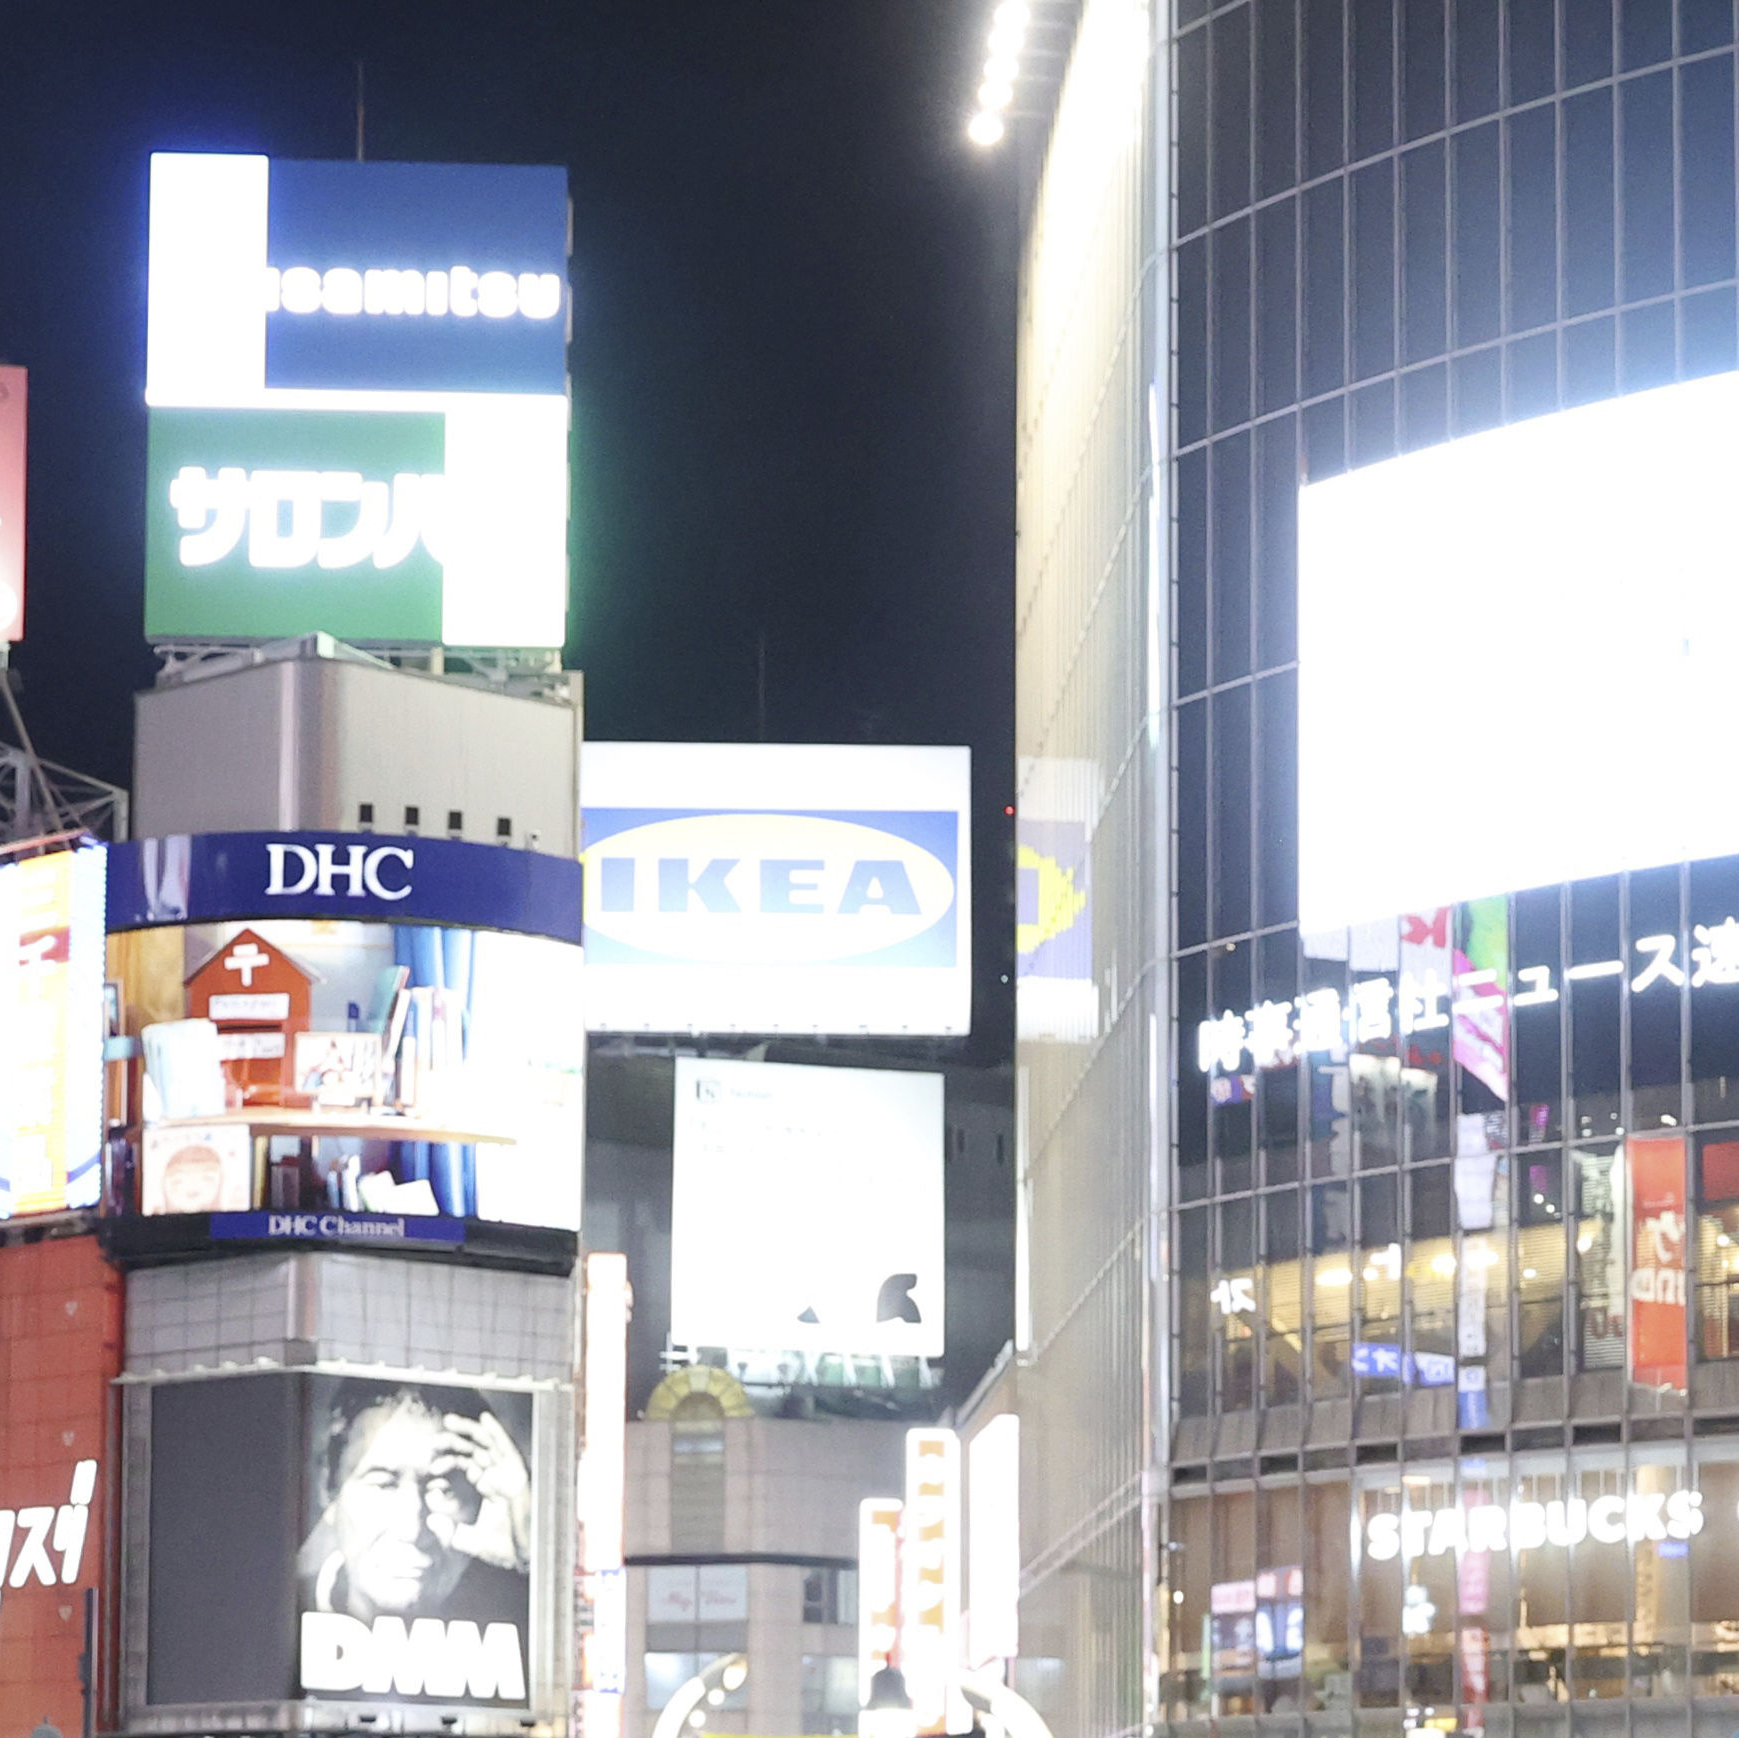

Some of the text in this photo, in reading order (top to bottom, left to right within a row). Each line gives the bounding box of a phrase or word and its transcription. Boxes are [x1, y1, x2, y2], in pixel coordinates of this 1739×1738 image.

[264, 842, 415, 900] DHC
[600, 856, 922, 915] IKEA
[268, 1215, 405, 1238] DHC Channel
[1367, 1489, 1704, 1561] STARBUCKS
[301, 1611, 525, 1699] DMM
